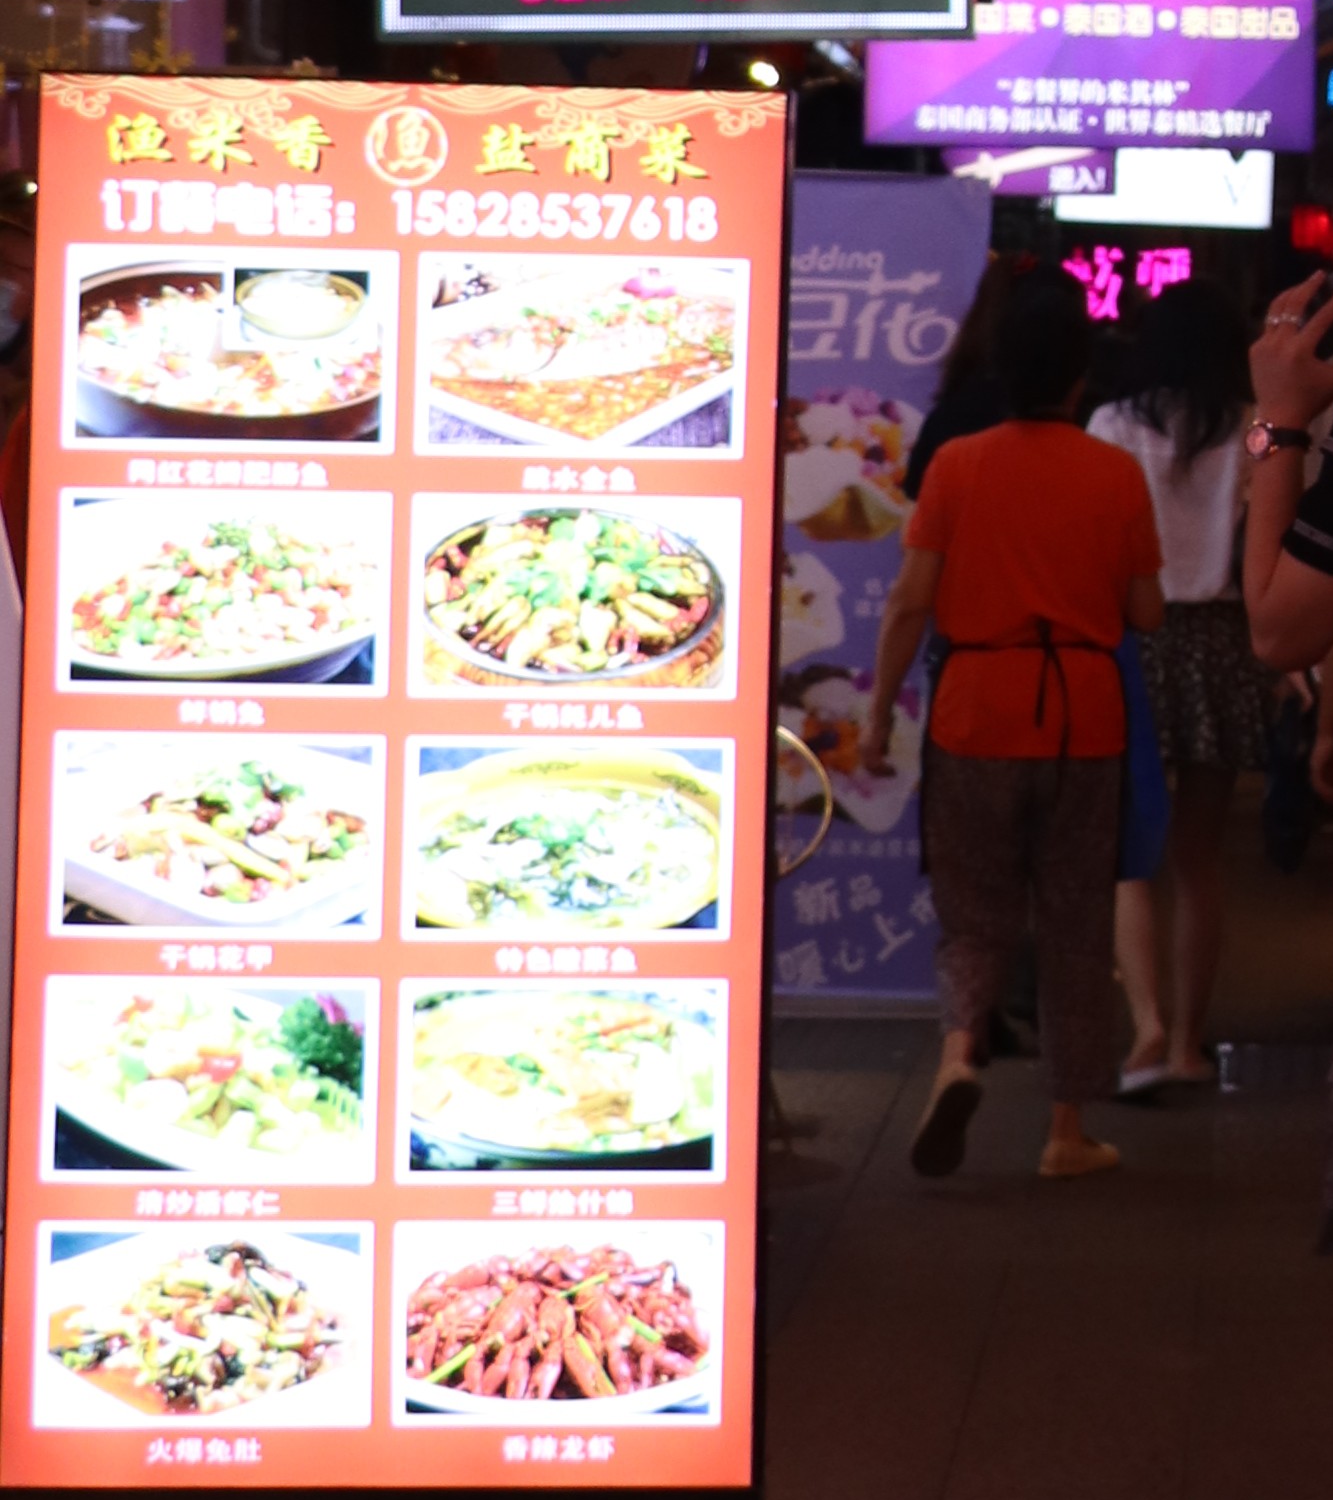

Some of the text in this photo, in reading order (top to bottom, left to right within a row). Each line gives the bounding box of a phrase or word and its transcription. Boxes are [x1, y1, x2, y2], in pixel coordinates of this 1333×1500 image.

[105, 112, 334, 172] 渔米香
[474, 123, 707, 185] 盐商菜
[391, 187, 719, 242] 15828537618
